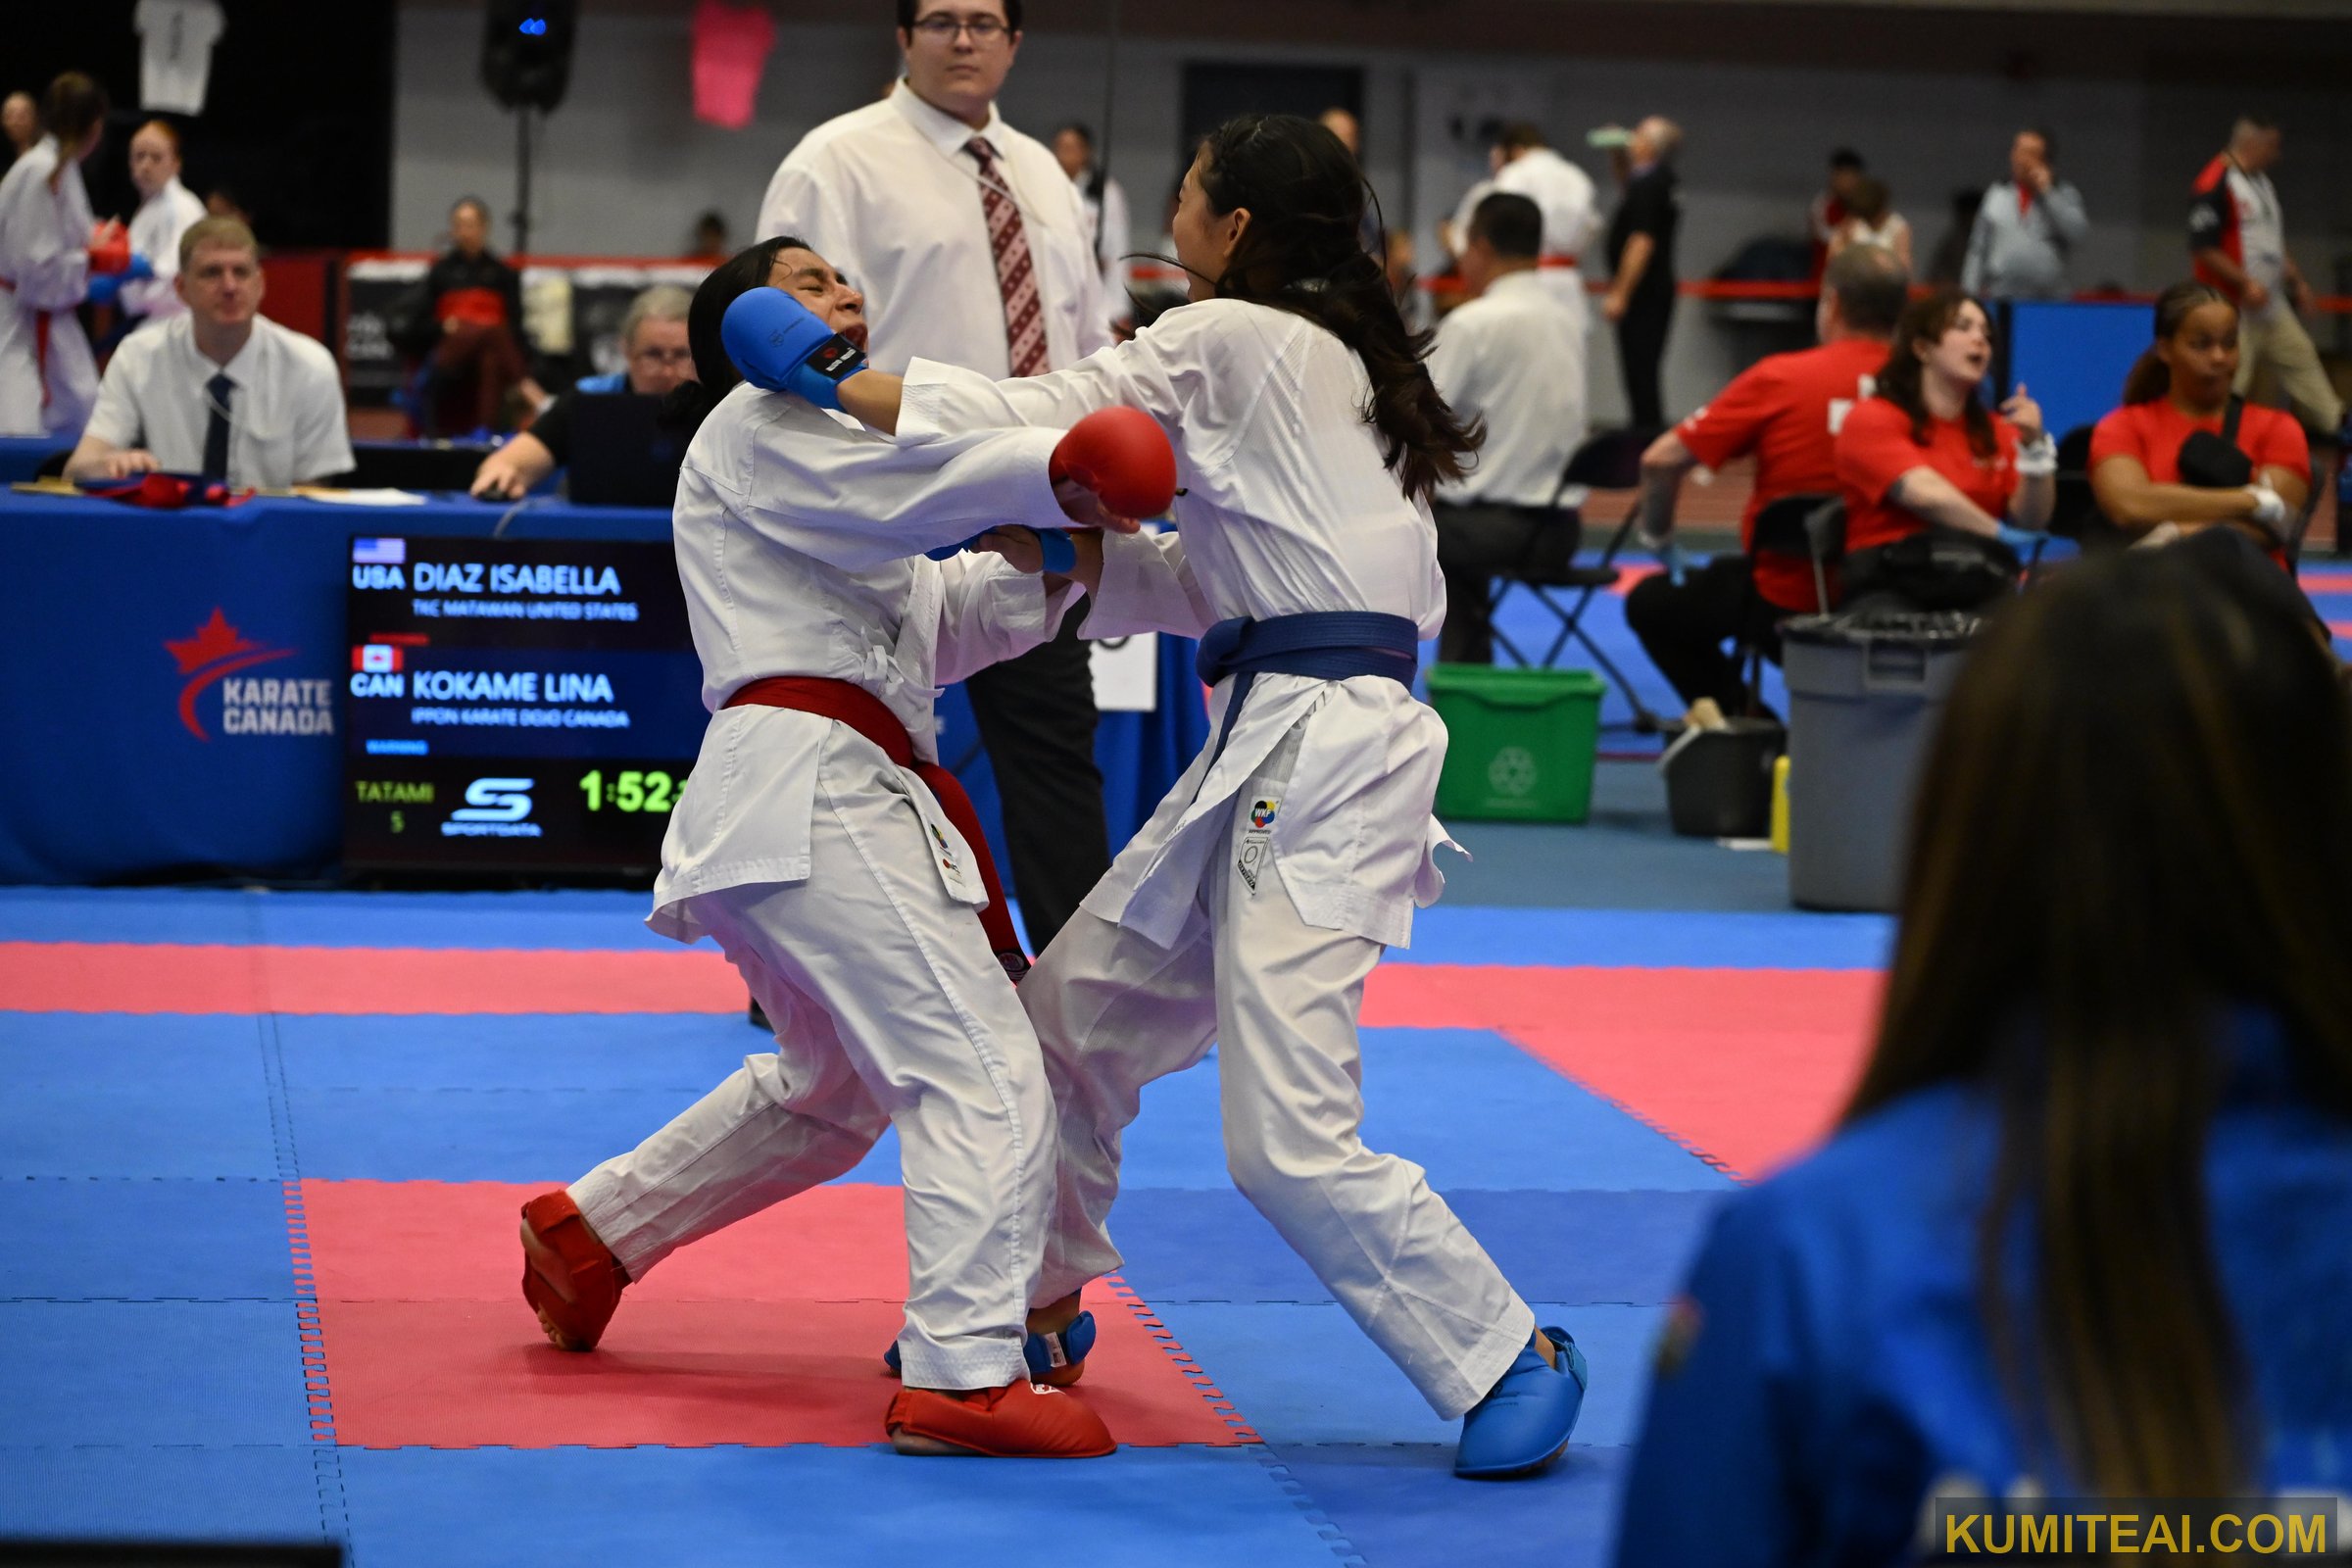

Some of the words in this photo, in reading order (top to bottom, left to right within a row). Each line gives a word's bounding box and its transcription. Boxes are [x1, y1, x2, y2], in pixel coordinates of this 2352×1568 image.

[352, 565, 405, 590] USA
[414, 563, 484, 593] DIAZ
[490, 564, 622, 595] ISABELLA
[526, 602, 583, 620] UNITED
[584, 603, 639, 621] STATES
[222, 677, 331, 706] KARATE
[351, 673, 405, 698] CAN
[413, 671, 538, 702] KOKAME
[544, 673, 613, 703] LINA
[222, 708, 334, 735] CANADA
[461, 709, 516, 726] KARATE
[563, 710, 630, 728] CANADA
[356, 781, 435, 803] TATAMI
[390, 810, 405, 833] 5
[1255, 808, 1273, 818] WKF
